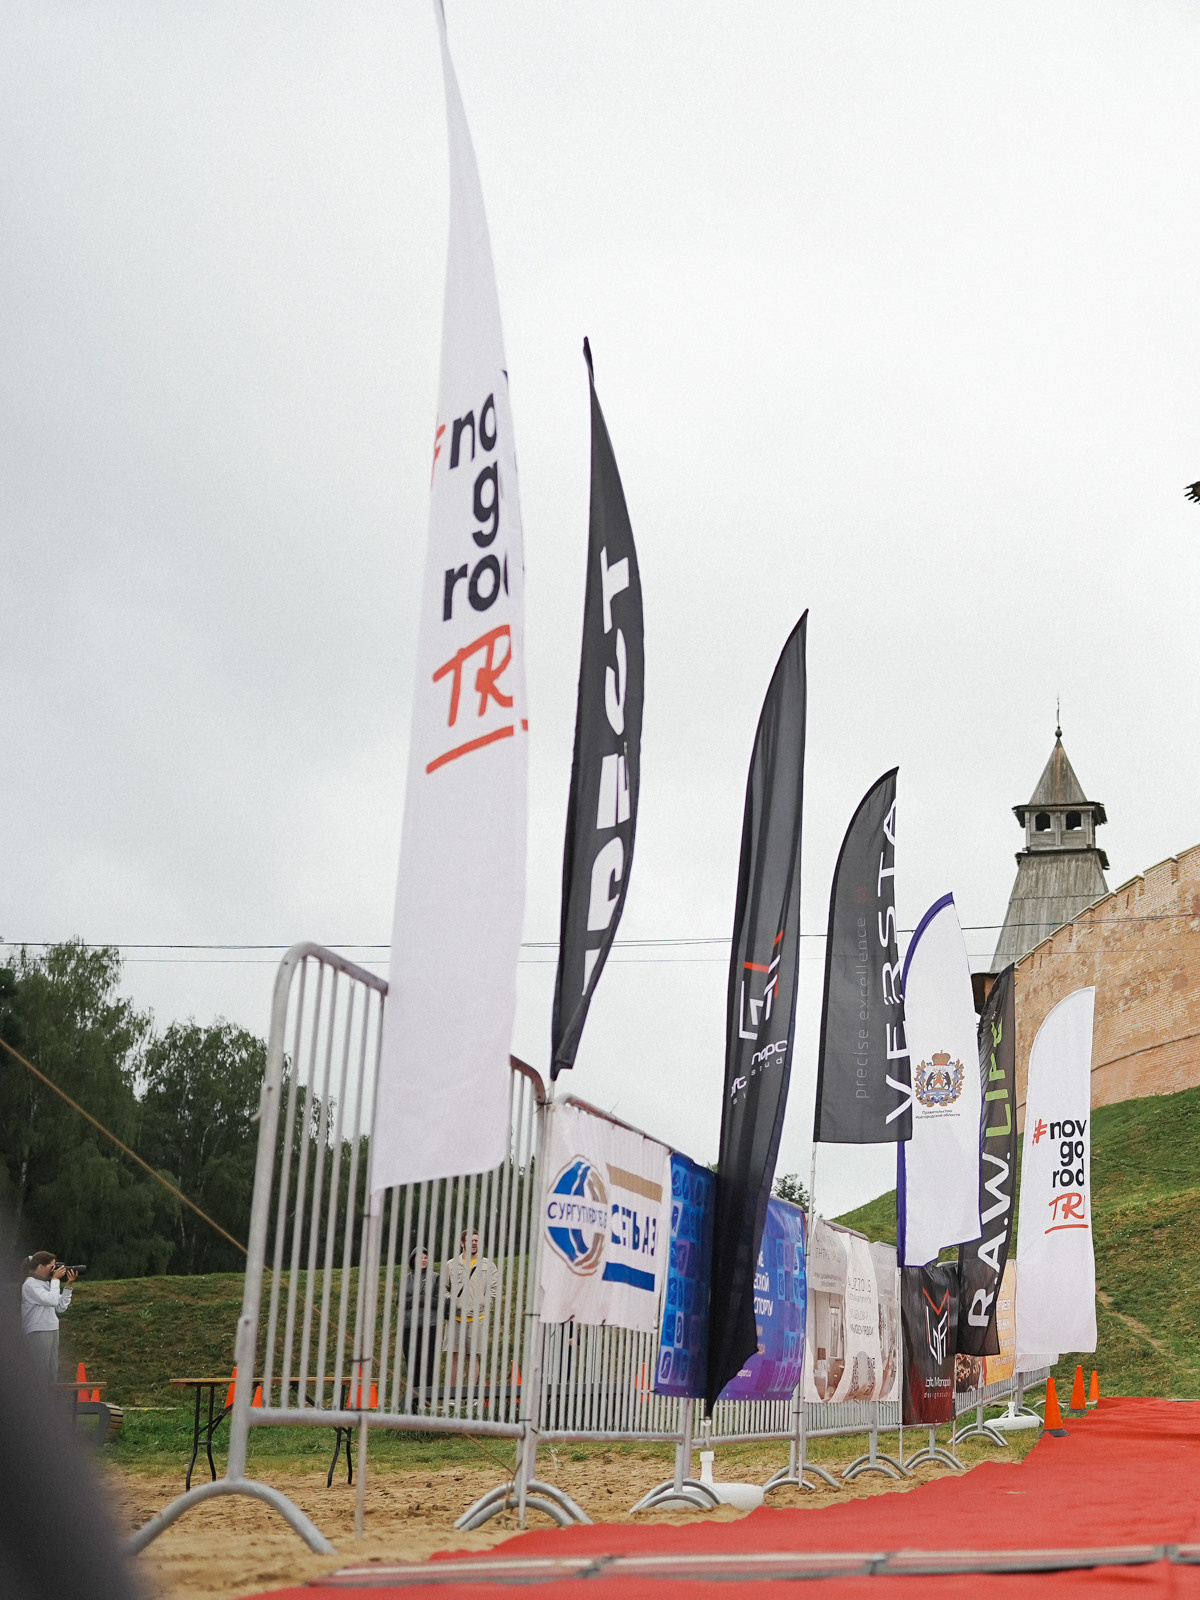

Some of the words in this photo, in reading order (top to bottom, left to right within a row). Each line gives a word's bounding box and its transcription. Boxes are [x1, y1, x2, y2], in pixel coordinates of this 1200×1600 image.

[472, 460, 500, 548] g
[443, 553, 510, 622] ro
[432, 624, 514, 728] TR
[854, 917, 870, 1022] excellence
[853, 1026, 870, 1100] precise
[1032, 1118, 1087, 1146] #nov
[1060, 1140, 1085, 1167] go
[1052, 1158, 1085, 1188] rod
